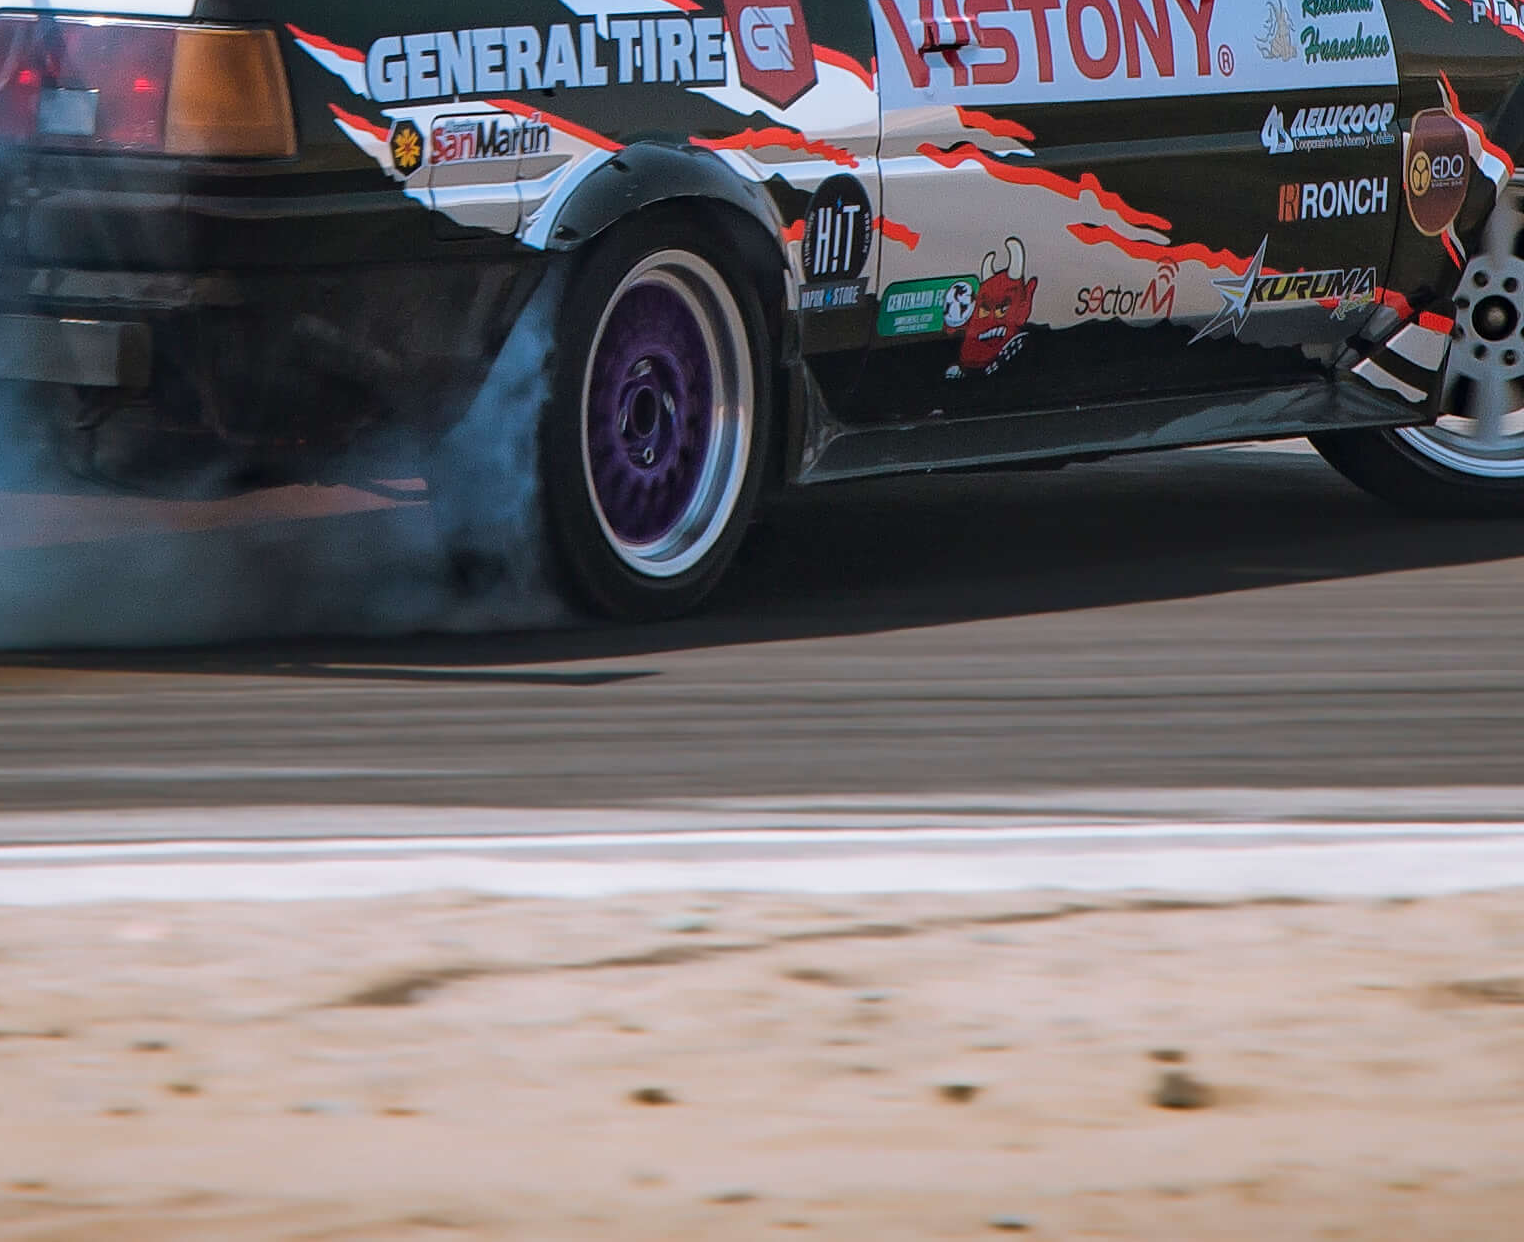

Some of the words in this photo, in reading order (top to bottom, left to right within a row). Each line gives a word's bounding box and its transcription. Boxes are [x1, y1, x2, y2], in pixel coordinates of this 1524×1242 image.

[365, 21, 608, 102] GENERAL
[608, 15, 726, 86] TIRE
[1299, 21, 1390, 65] Huanchaco
[1431, 154, 1464, 179] EDO
[1301, 176, 1388, 220] RONCH
[1242, 268, 1376, 308] KURUMA
